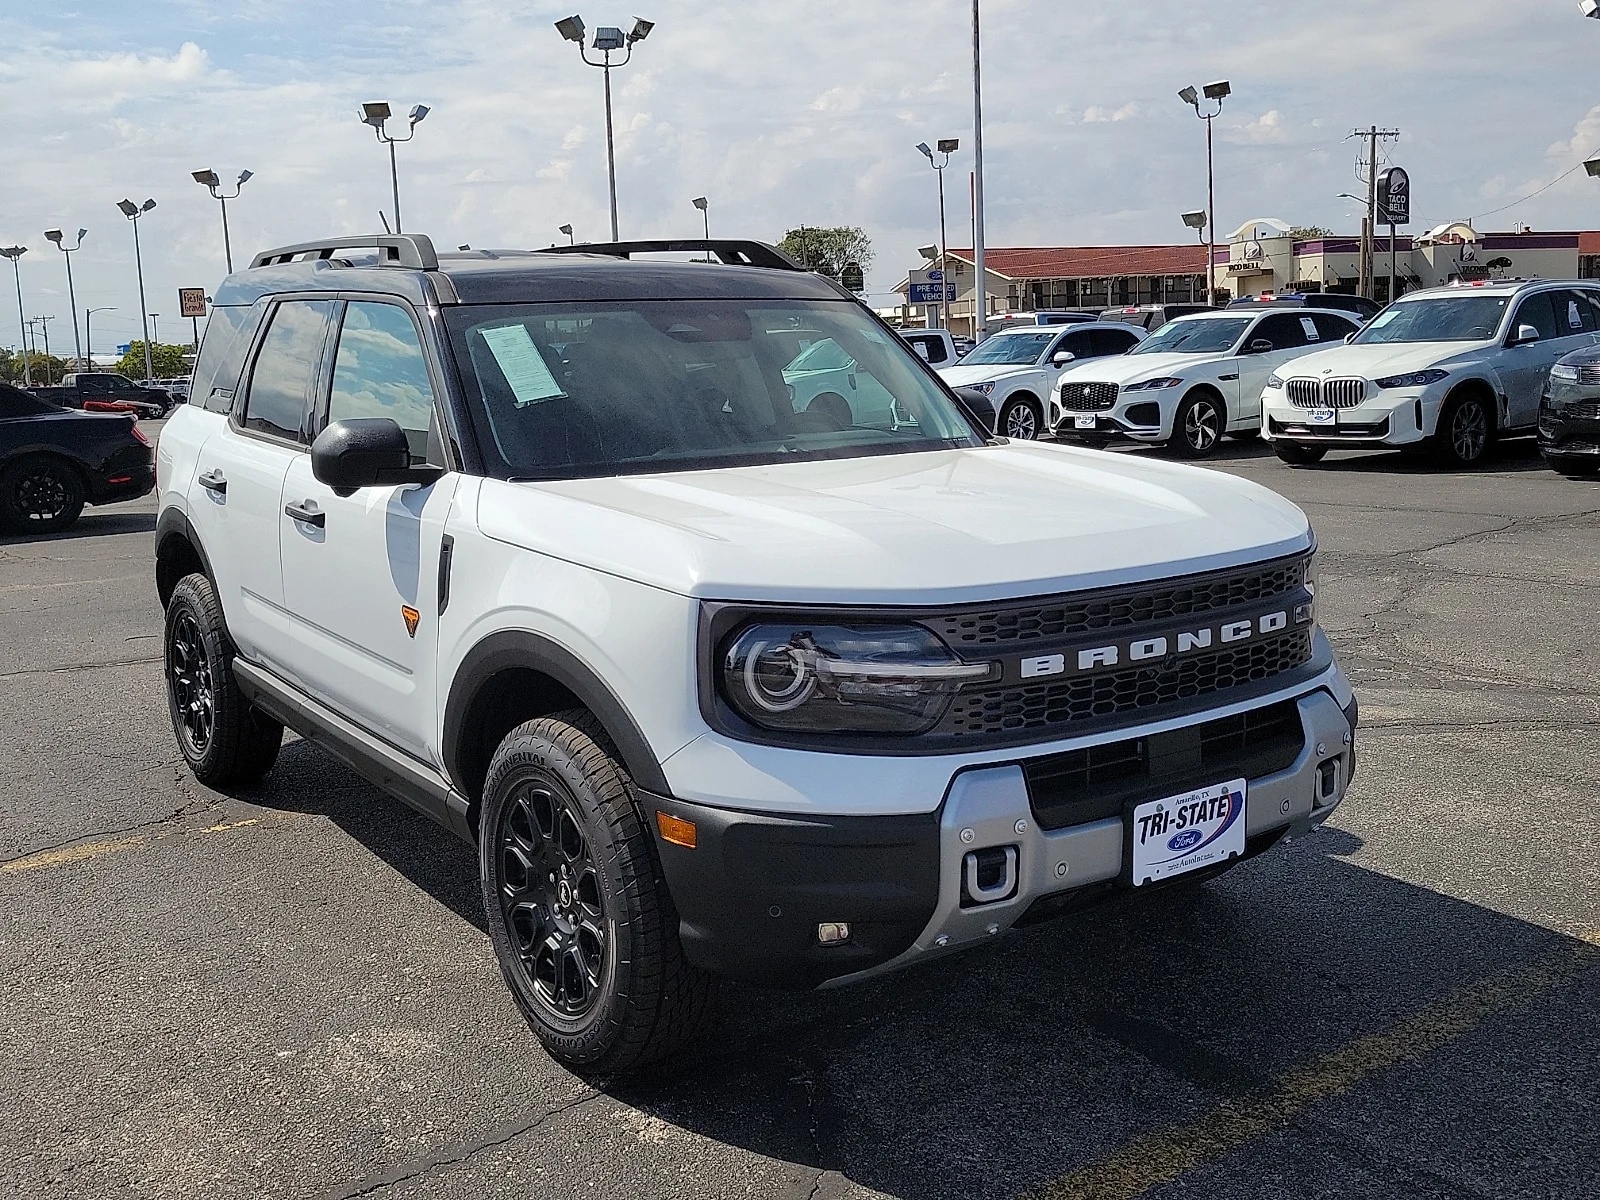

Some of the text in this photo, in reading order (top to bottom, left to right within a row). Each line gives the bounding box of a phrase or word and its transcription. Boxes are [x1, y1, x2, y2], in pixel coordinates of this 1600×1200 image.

[1388, 195, 1406, 204] TACO
[1390, 204, 1405, 212] BELL
[916, 284, 955, 292] PRE-OWED
[183, 291, 203, 302] Fiesta
[184, 302, 204, 312] Grande
[1020, 610, 1287, 678] BRONCO
[1201, 790, 1210, 799] TX
[1137, 795, 1229, 846] TRI-STATE
[1174, 833, 1196, 848] Ford
